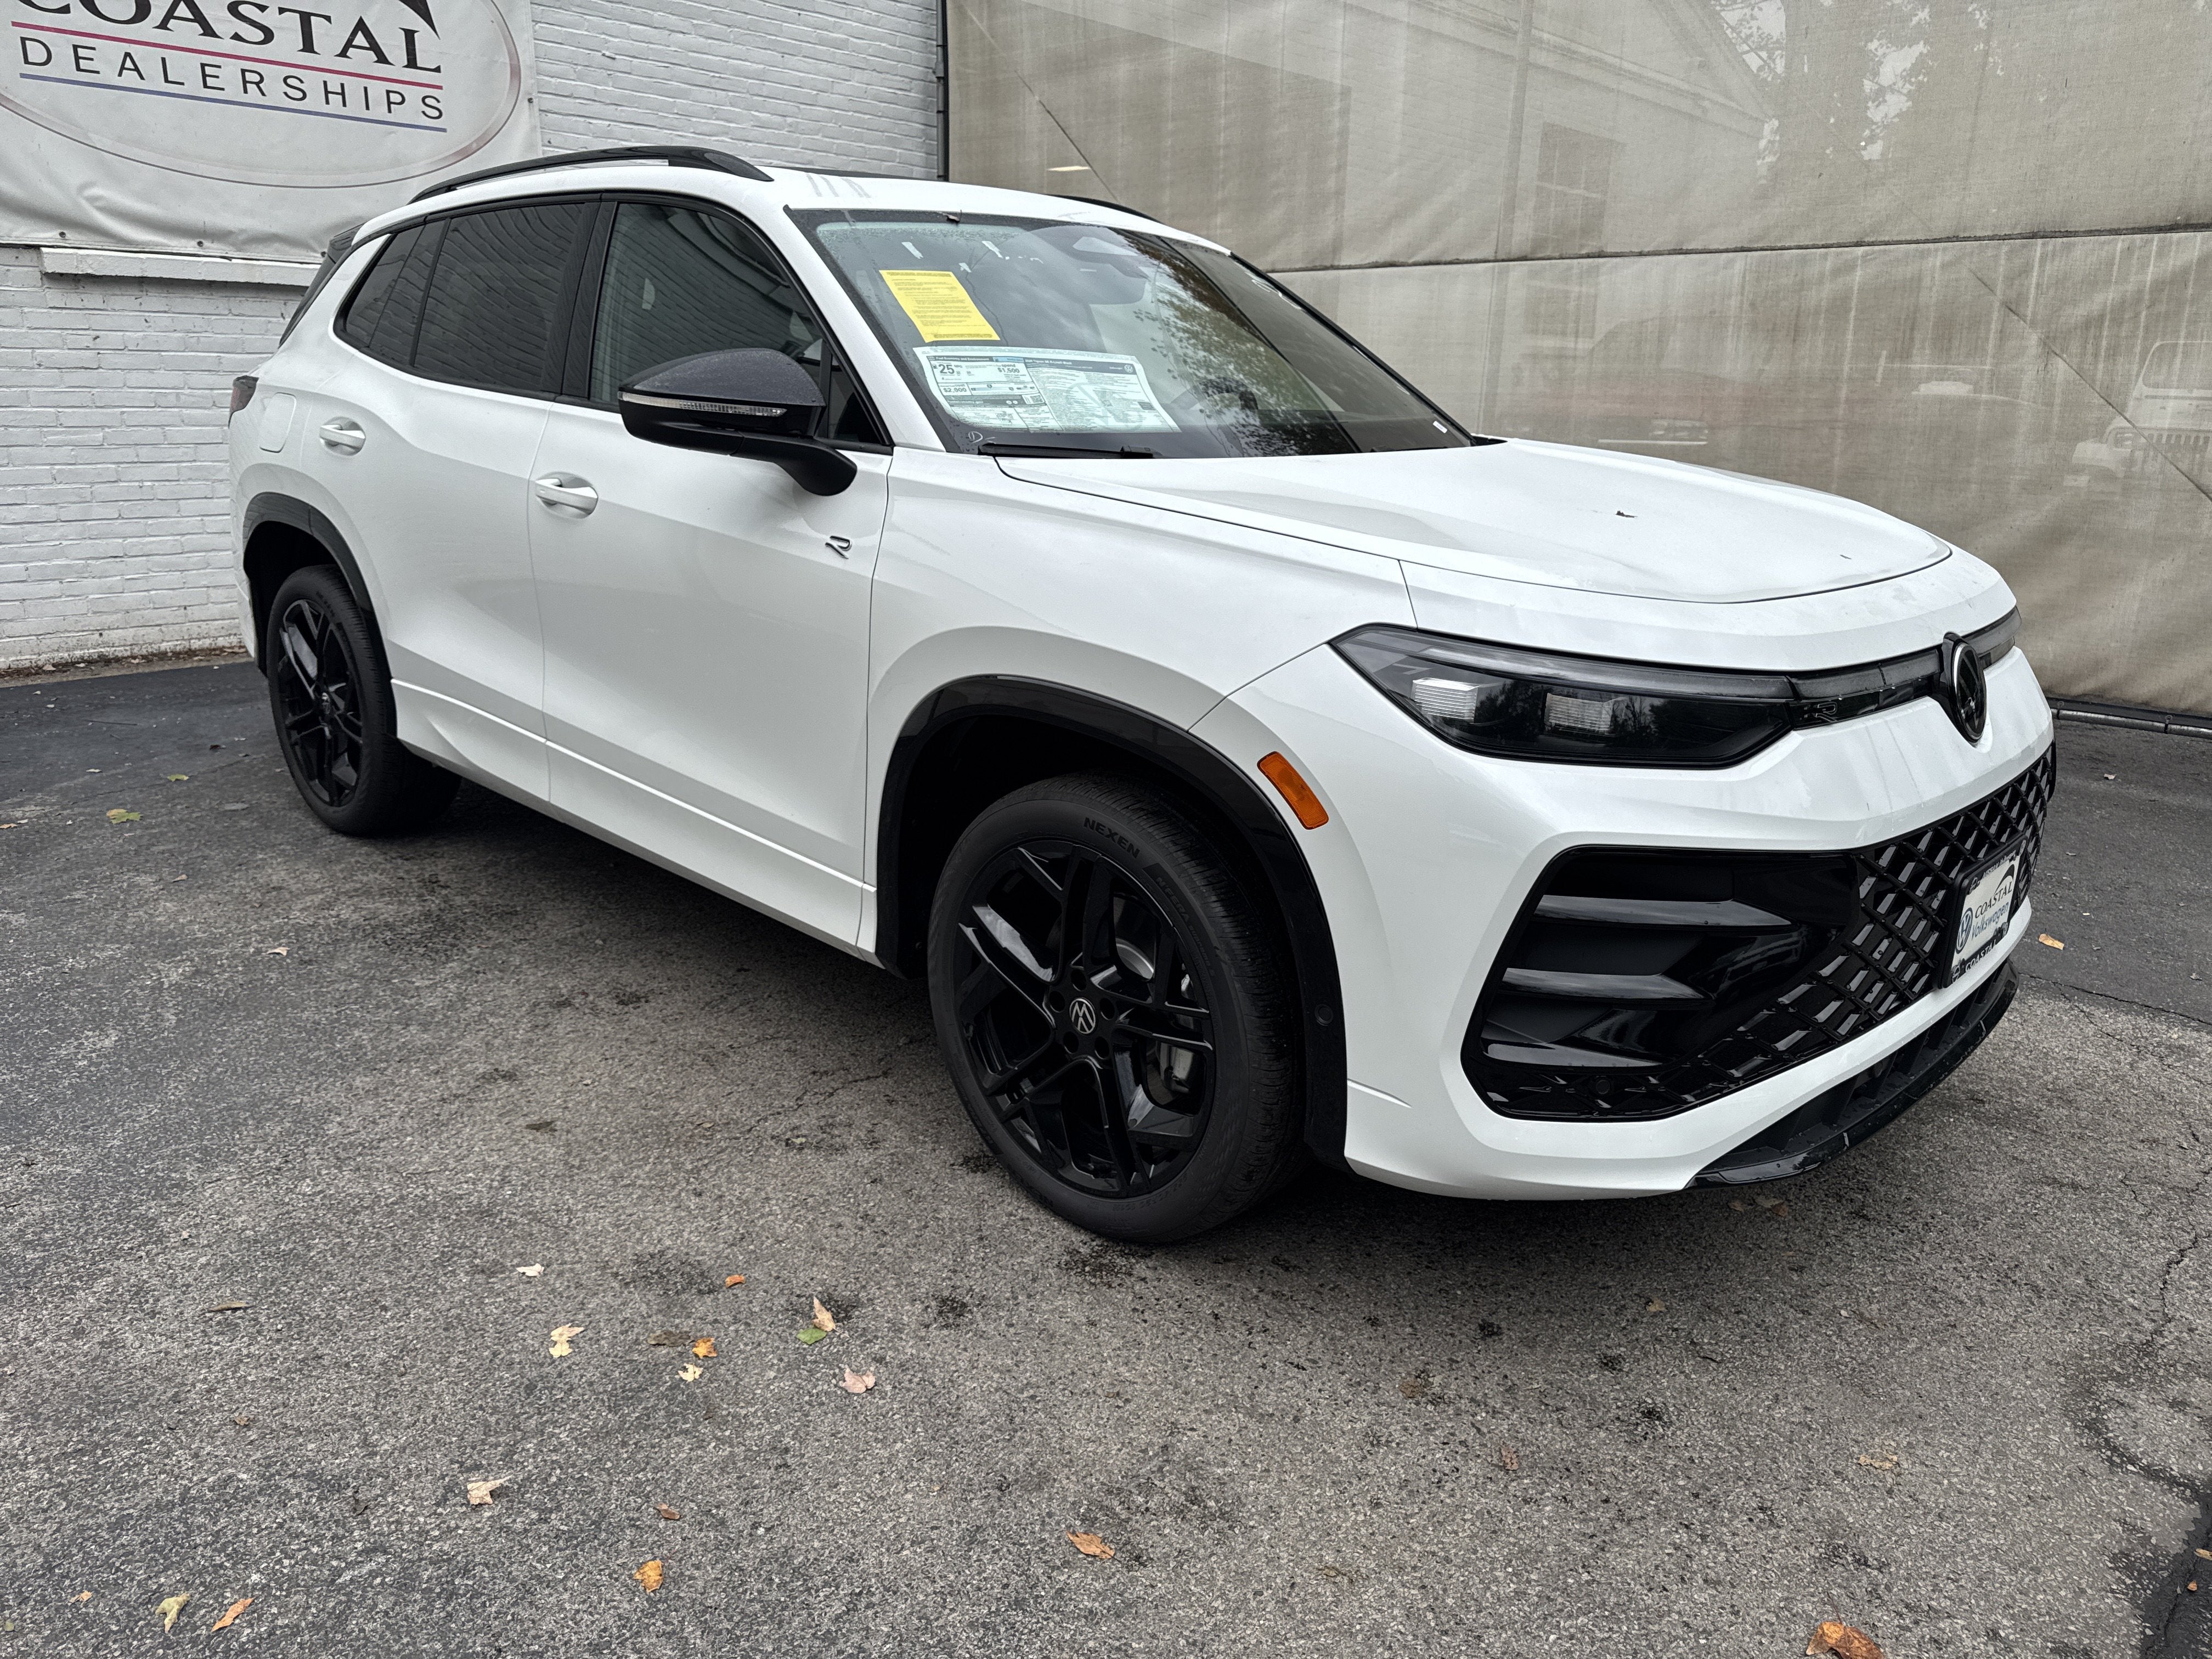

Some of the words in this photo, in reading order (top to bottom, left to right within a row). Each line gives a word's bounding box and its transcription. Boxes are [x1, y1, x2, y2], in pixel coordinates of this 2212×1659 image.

[20, 36, 443, 120] DEALERSHIPS
[938, 364, 955, 374] 25
[1084, 817, 1141, 859] NEXEN
[1974, 881, 2014, 918] COASTAL
[1972, 901, 2009, 941] Volkswagen
